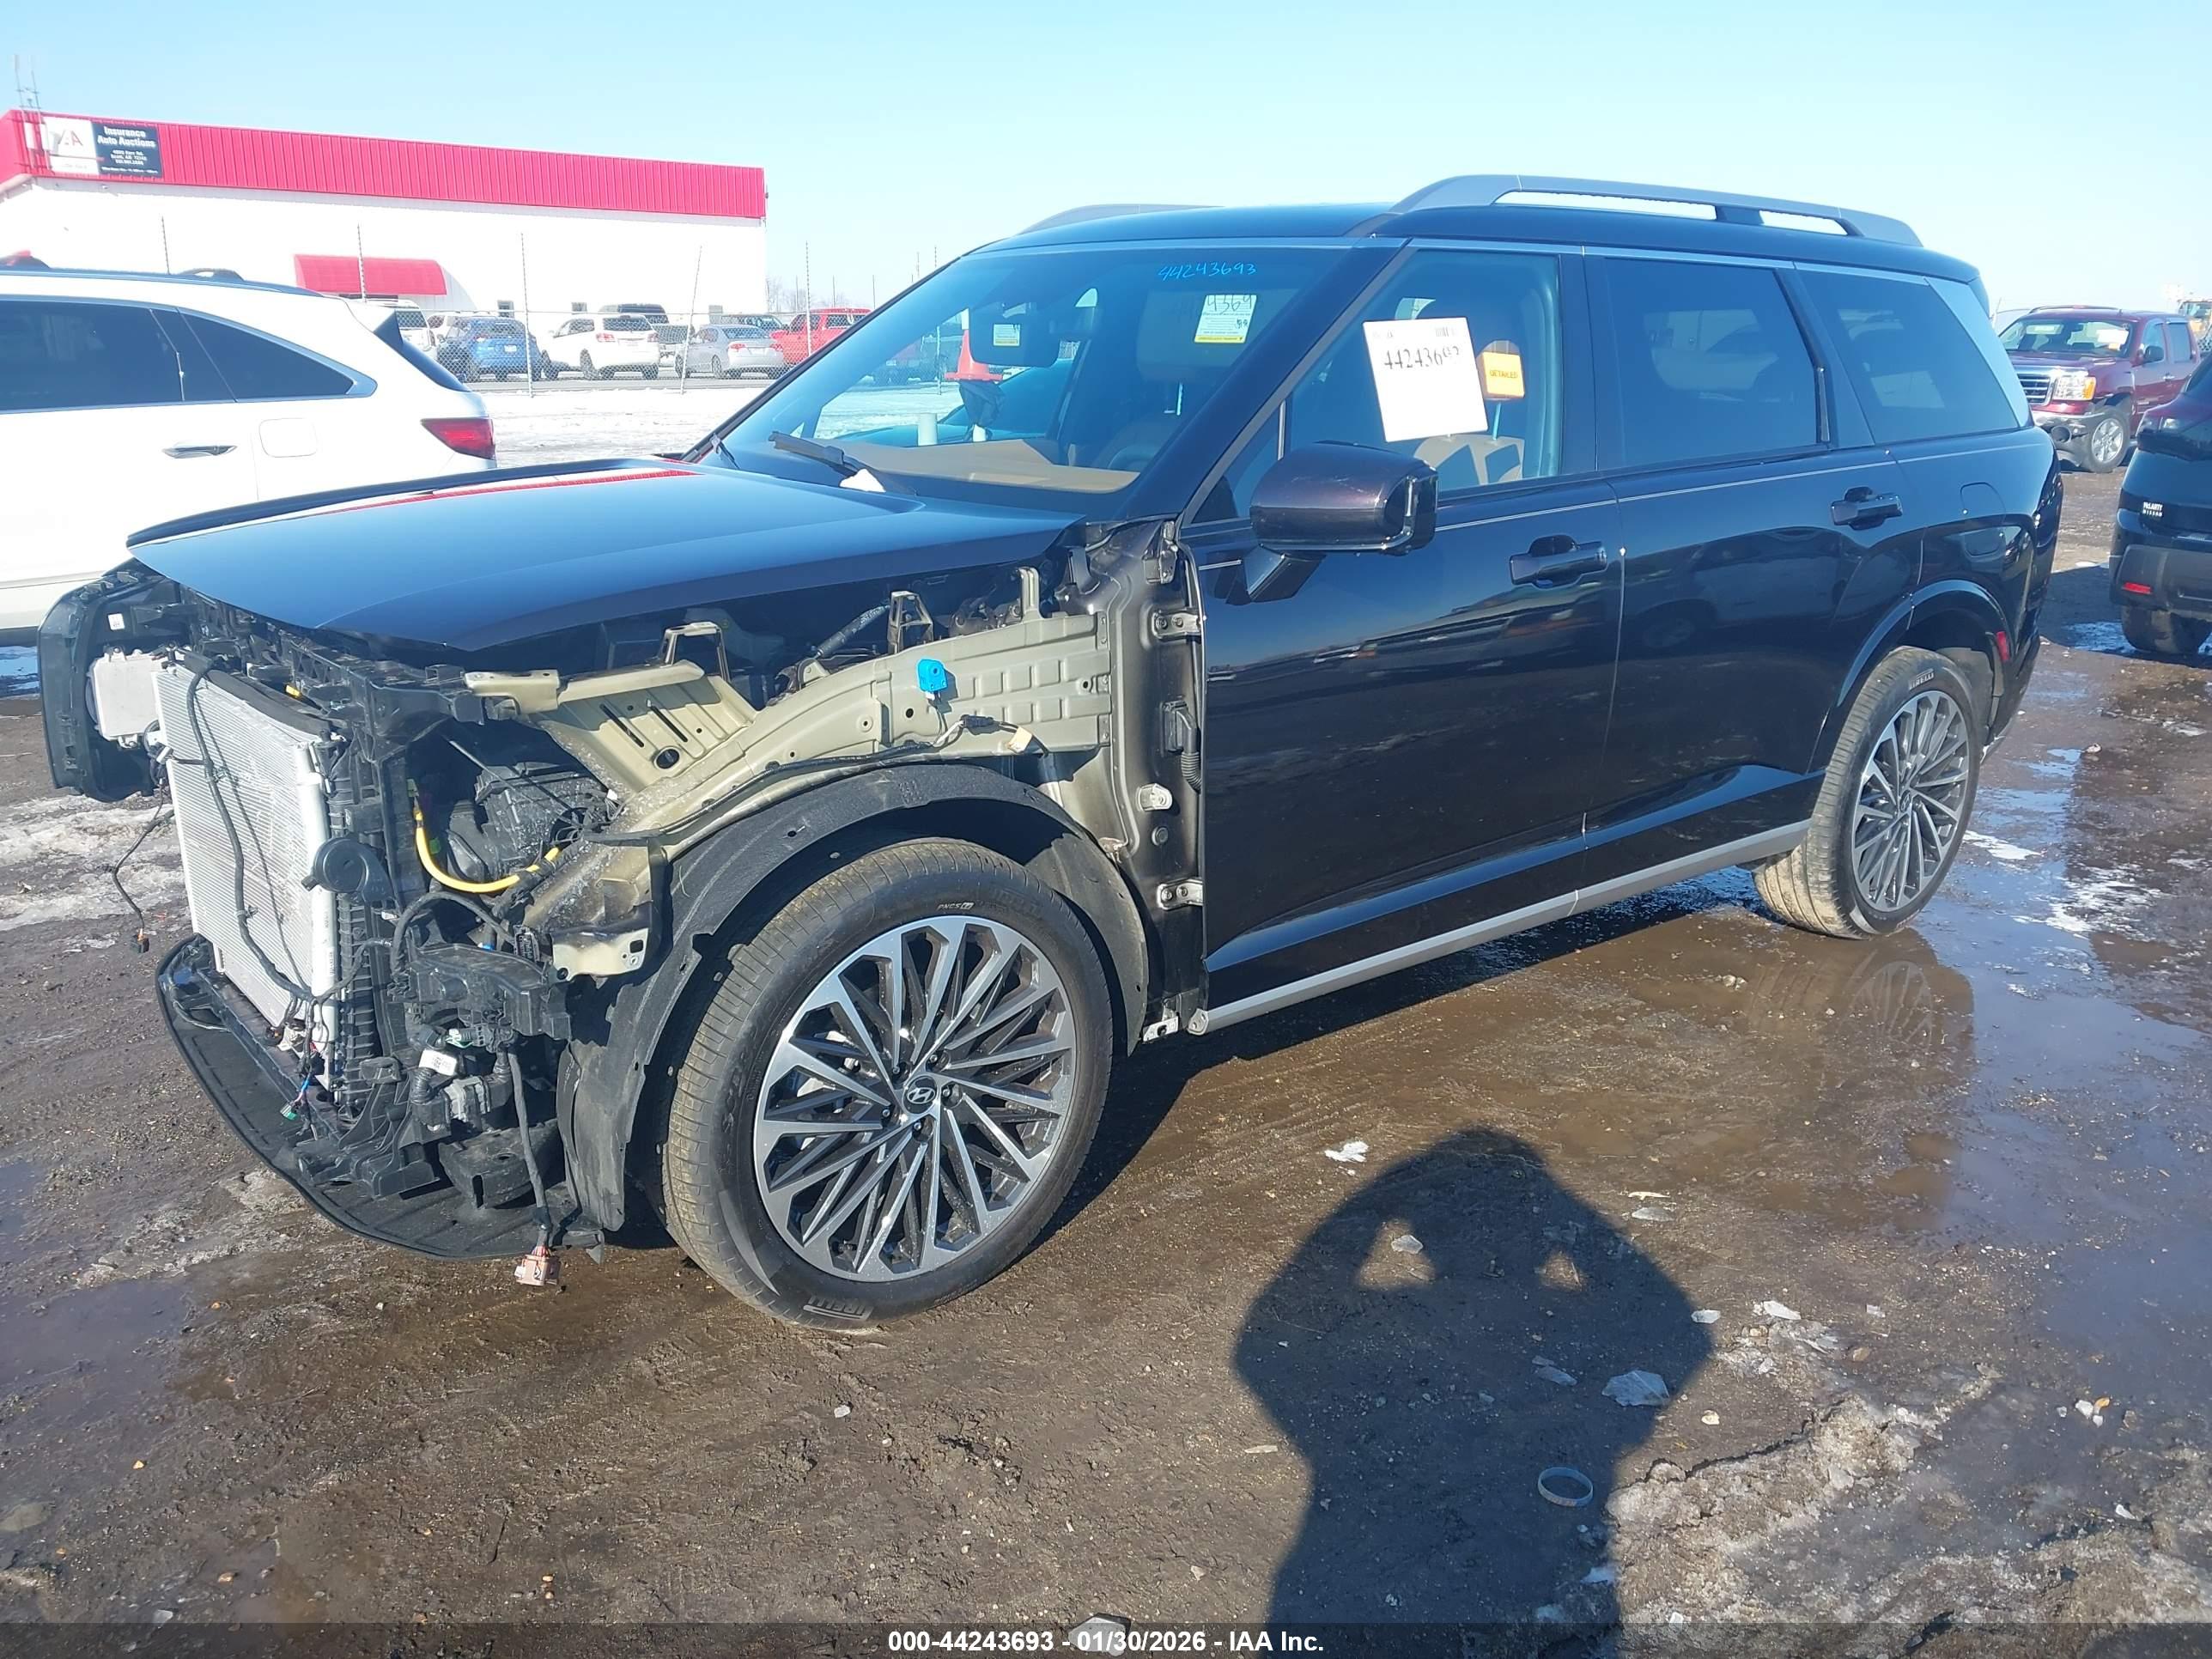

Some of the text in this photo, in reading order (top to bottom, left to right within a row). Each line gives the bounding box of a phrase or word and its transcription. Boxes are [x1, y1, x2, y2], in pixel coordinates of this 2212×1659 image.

[103, 125, 146, 138] Insurance
[97, 134, 157, 149] Auto Auctions
[1158, 261, 1257, 282] 44243693
